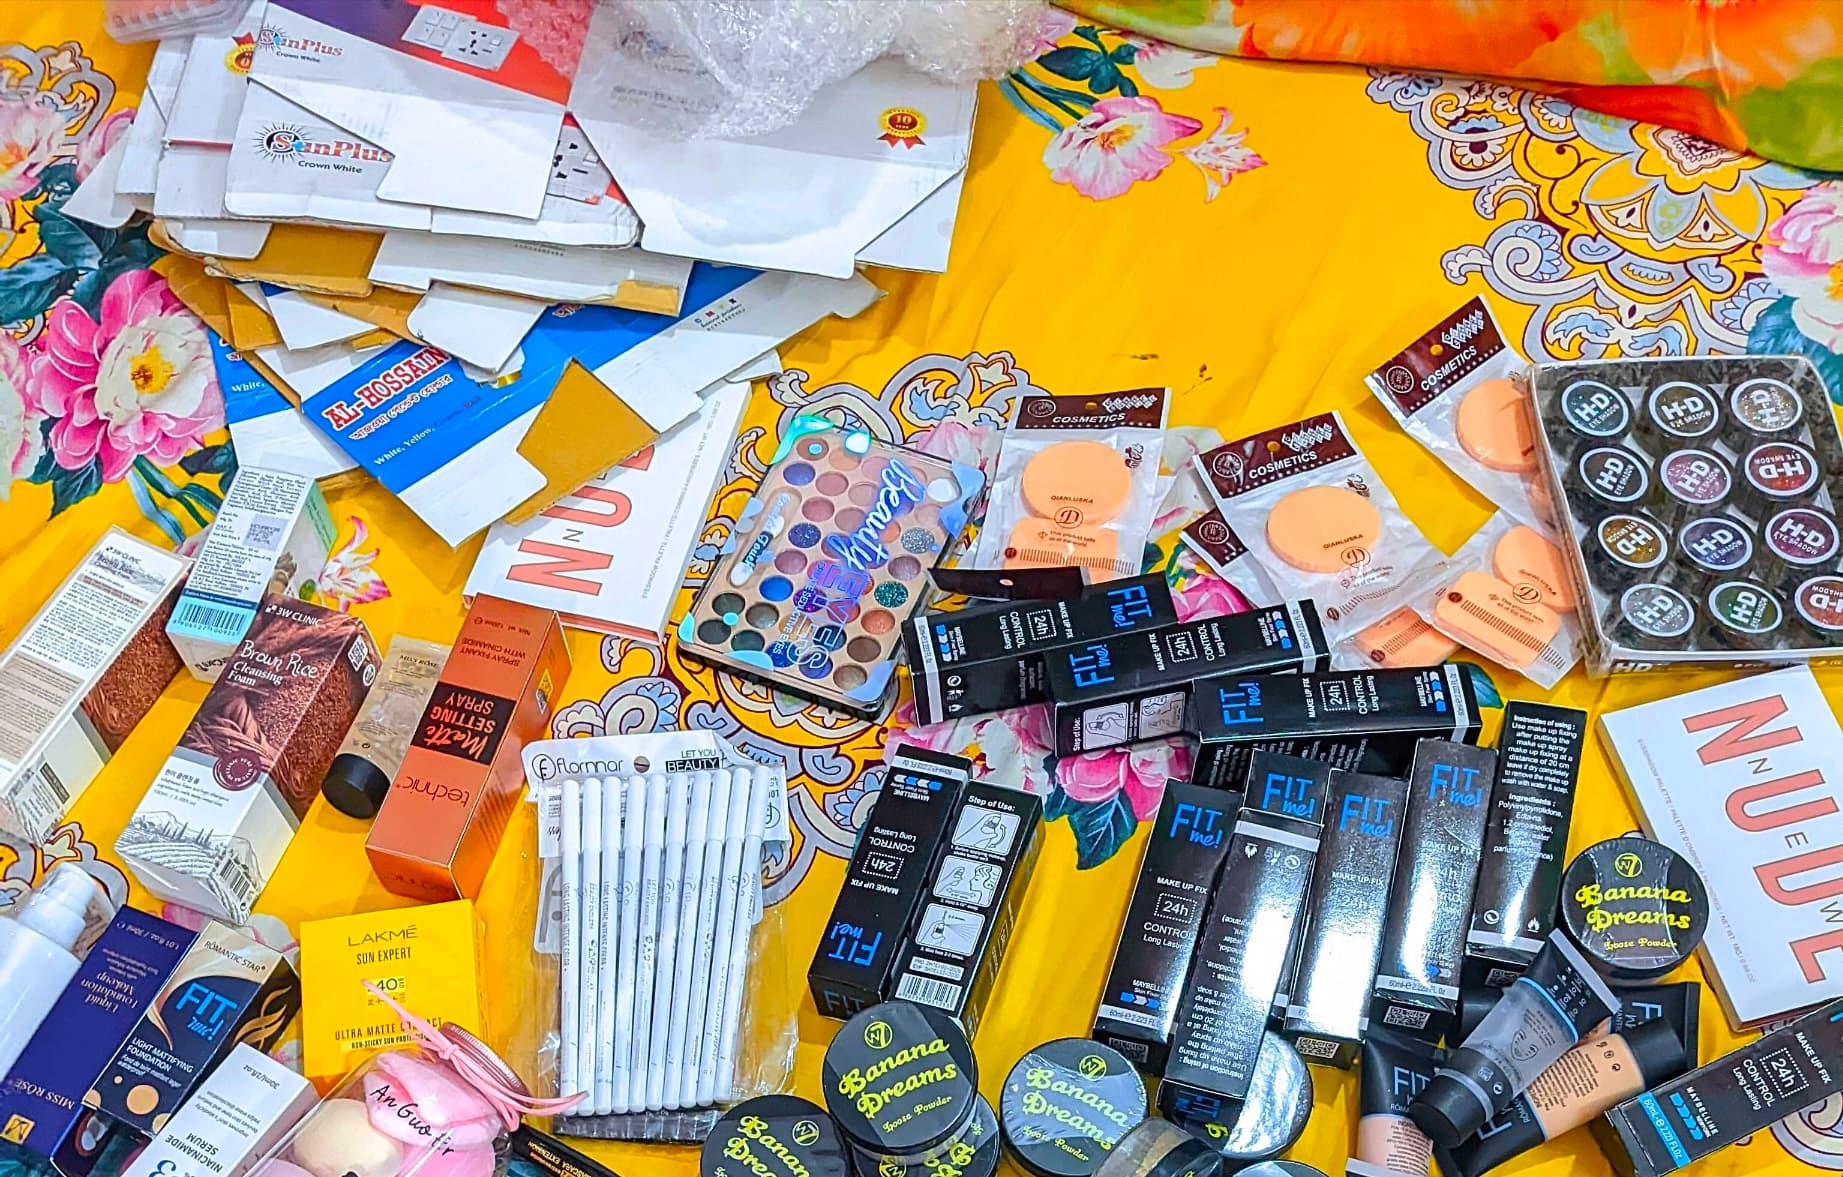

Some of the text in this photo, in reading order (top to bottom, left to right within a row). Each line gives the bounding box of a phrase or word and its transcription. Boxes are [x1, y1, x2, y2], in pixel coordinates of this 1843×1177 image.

[895, 113, 912, 125] 10
[298, 160, 362, 174] Crown White
[1421, 345, 1477, 391] COSMETICS
[324, 346, 449, 429] AL-HOSSAIN
[1052, 413, 1125, 423] COSMETICS
[1248, 451, 1317, 479] COSMETICS
[277, 607, 291, 618] 3W
[1106, 585, 1152, 618] FIT
[1009, 611, 1025, 649] CONTROL
[1036, 615, 1048, 635] 24h
[240, 640, 318, 678] Brown Rice
[227, 671, 256, 686] Foam
[233, 661, 283, 685] Cleansing
[447, 692, 494, 714] SPRAY
[1220, 688, 1264, 725] FIT
[1330, 685, 1343, 705] 24h
[1353, 676, 1367, 715] CONTROL
[431, 708, 497, 734] SETTING
[1510, 722, 1577, 739] Use make up fixing
[1512, 714, 1572, 730] Instruction of using
[424, 726, 490, 760] Matte
[1514, 730, 1571, 745] after putting the
[1515, 738, 1568, 753] make up spray
[667, 759, 719, 772] BEAUTY
[681, 749, 717, 758] LET YOU
[1507, 753, 1571, 769] distance of 20 cm
[404, 775, 470, 807] technic
[1261, 773, 1312, 809] FIT
[1428, 764, 1481, 800] FIT
[968, 796, 1015, 813] Step of Use:
[1339, 794, 1390, 831] FIT
[869, 836, 915, 853] CONTROL
[874, 826, 916, 841] Long Lasting
[871, 858, 896, 873] 24h
[1157, 877, 1209, 895] MAKE UP FIX
[1576, 884, 1692, 909] Banana
[1163, 900, 1189, 917] 24h
[1587, 910, 1691, 932] Dreams
[347, 924, 418, 947] LAKMÉ
[1638, 938, 1678, 948] Powder
[357, 947, 412, 965] SUN EXPERT
[829, 932, 882, 967] FIT
[81, 978, 138, 1007] Foundation
[97, 971, 133, 996] Makeup
[377, 978, 398, 991] 40
[84, 992, 118, 1014] Liquid
[175, 982, 238, 1022] FIT
[335, 1023, 397, 1041] ULTRA MATTE
[127, 1045, 172, 1072] FOUNDATION
[132, 1036, 195, 1074] LIGHT MATTIFYING
[1794, 1031, 1832, 1084] MAKE UP FIX
[839, 1038, 950, 1099] Banana
[1772, 1059, 1795, 1088] 24h
[857, 1063, 957, 1119] Dreams
[1732, 1067, 1761, 1112] Long Lasting
[1743, 1059, 1773, 1108] CONTROL
[45, 1090, 75, 1110] MISS
[914, 1096, 952, 1115] Powder
[1026, 1068, 1130, 1128] Banana
[1022, 1091, 1116, 1151] Dreams
[1687, 1086, 1719, 1135] MAYBELLINE
[165, 1136, 223, 1173] NIACINAMIDE
[187, 1133, 219, 1156] SERUM
